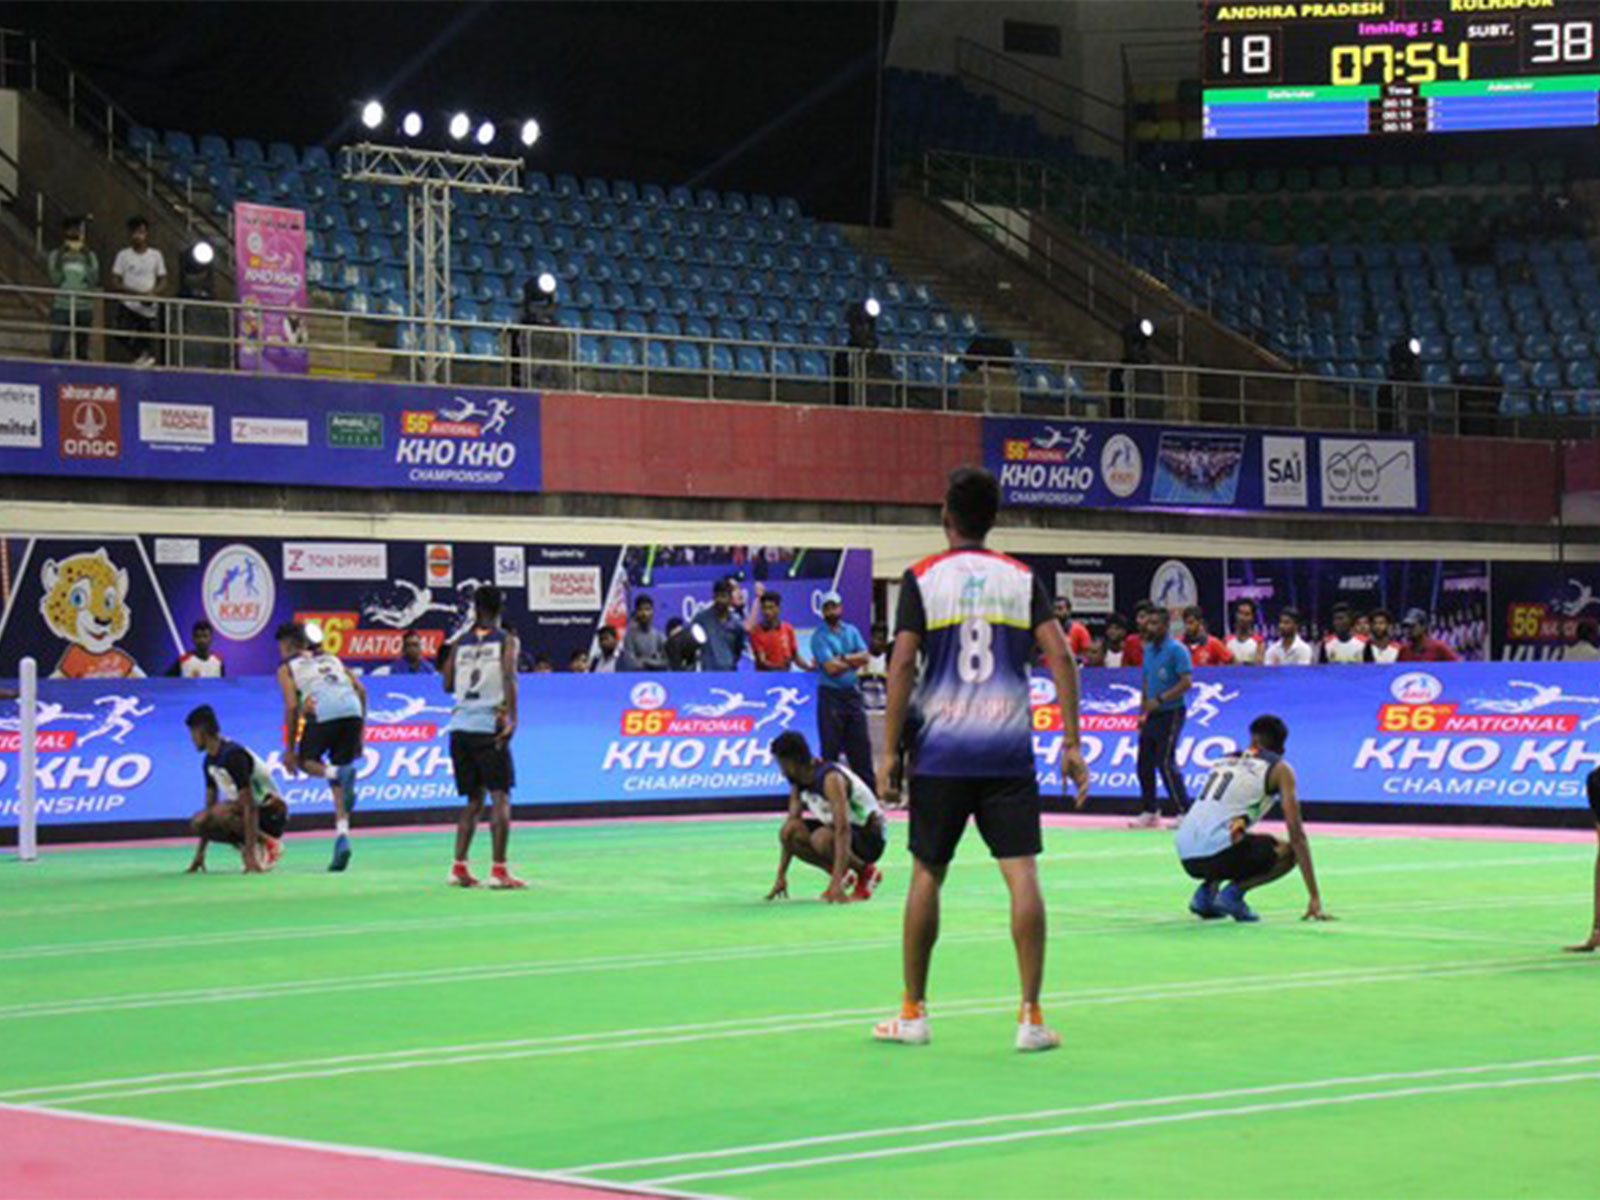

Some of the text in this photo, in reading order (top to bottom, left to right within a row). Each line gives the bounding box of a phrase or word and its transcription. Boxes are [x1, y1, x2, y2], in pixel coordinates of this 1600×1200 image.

[1217, 2, 1385, 20] ANDHRA PRADESH
[1358, 22, 1418, 37] Inning
[1431, 19, 1444, 33] 2
[1467, 23, 1514, 38] SUBT.
[1221, 35, 1271, 74] 18
[1531, 22, 1593, 63] 38
[1331, 42, 1470, 86] 07:54
[396, 438, 516, 468] KHO KHO
[409, 469, 505, 483] CHAMPIONSHIP
[1001, 465, 1046, 488] KHO
[1048, 467, 1094, 490] KHO
[957, 618, 994, 683] 8
[668, 719, 748, 733] NATIONAL
[1443, 717, 1566, 733] NATIONAL
[602, 738, 706, 770] KHO
[1353, 737, 1501, 771] KHO
